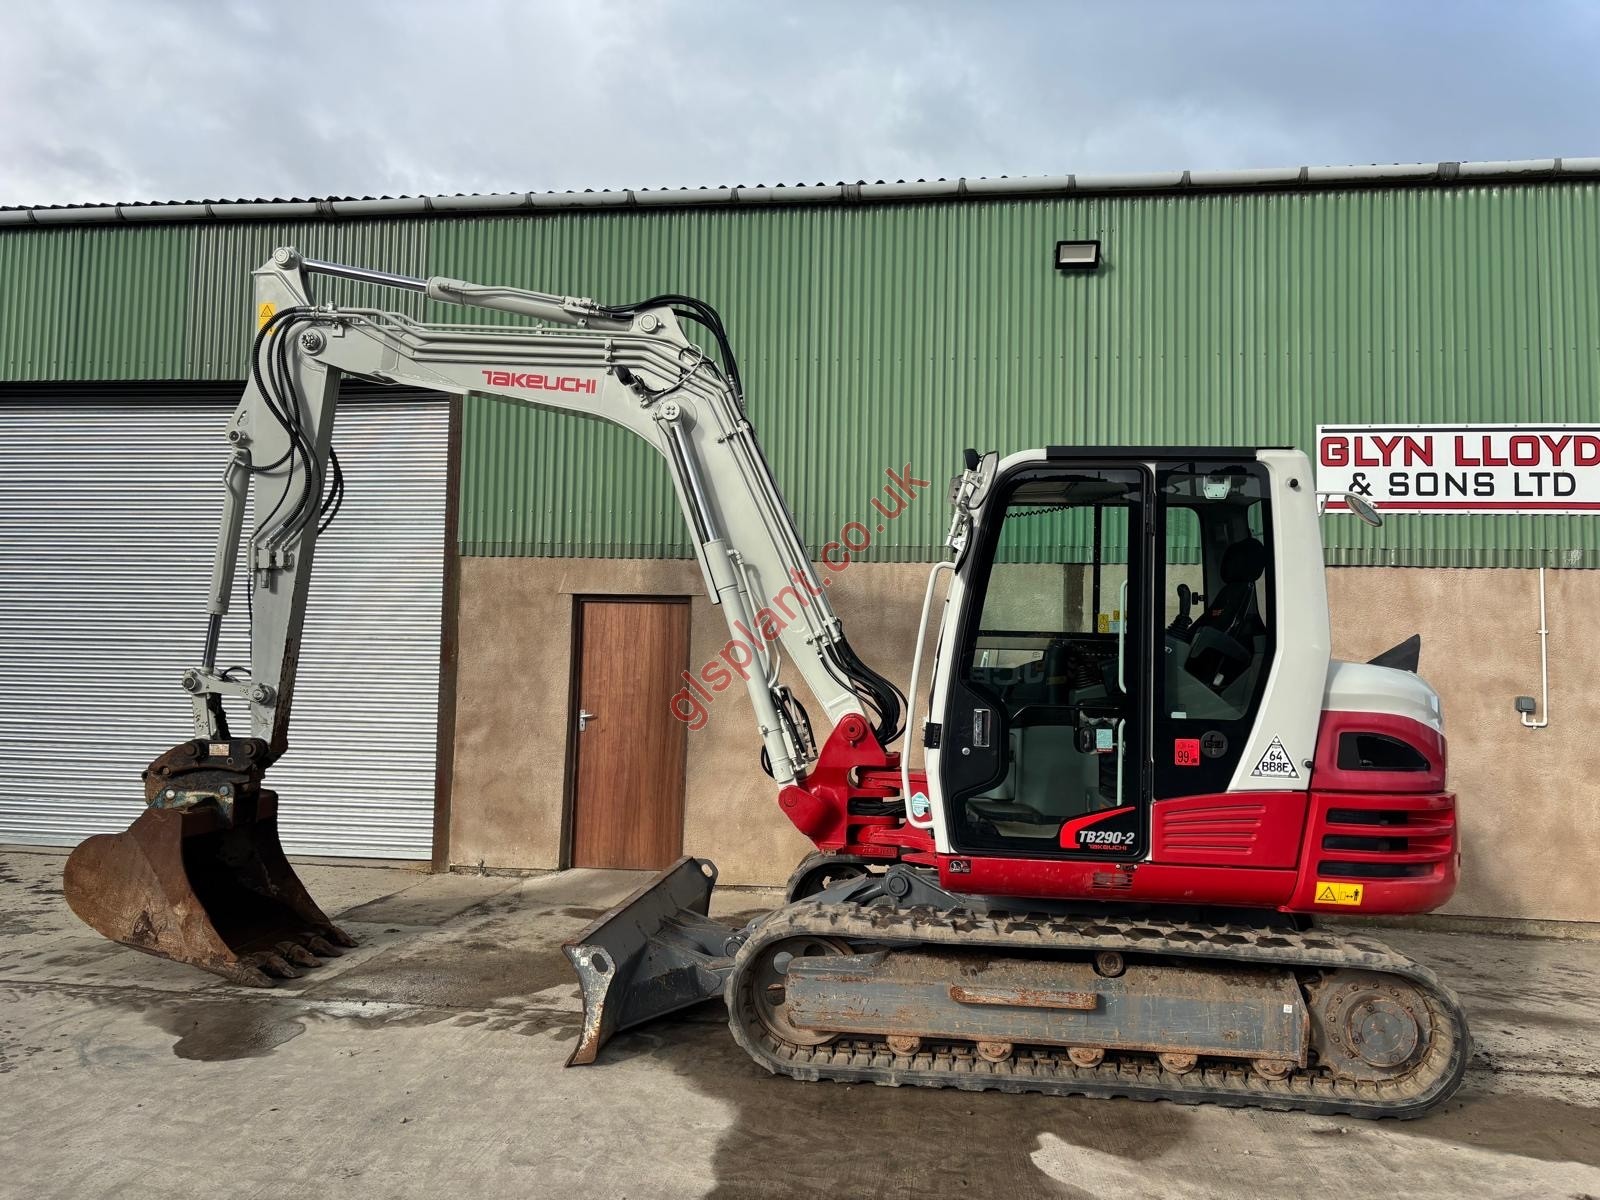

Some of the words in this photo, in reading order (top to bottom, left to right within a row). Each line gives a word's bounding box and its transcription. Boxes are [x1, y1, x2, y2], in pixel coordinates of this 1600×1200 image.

[1320, 436, 1433, 467] GLYN
[1455, 435, 1600, 467] LLOYD
[1349, 472, 1374, 496] &
[1389, 472, 1495, 497] SONS
[1514, 472, 1577, 497] LTD
[1177, 750, 1190, 763] 99
[1269, 750, 1283, 761] 64
[1261, 761, 1290, 773] BB8E
[1079, 830, 1135, 844] TB290-2
